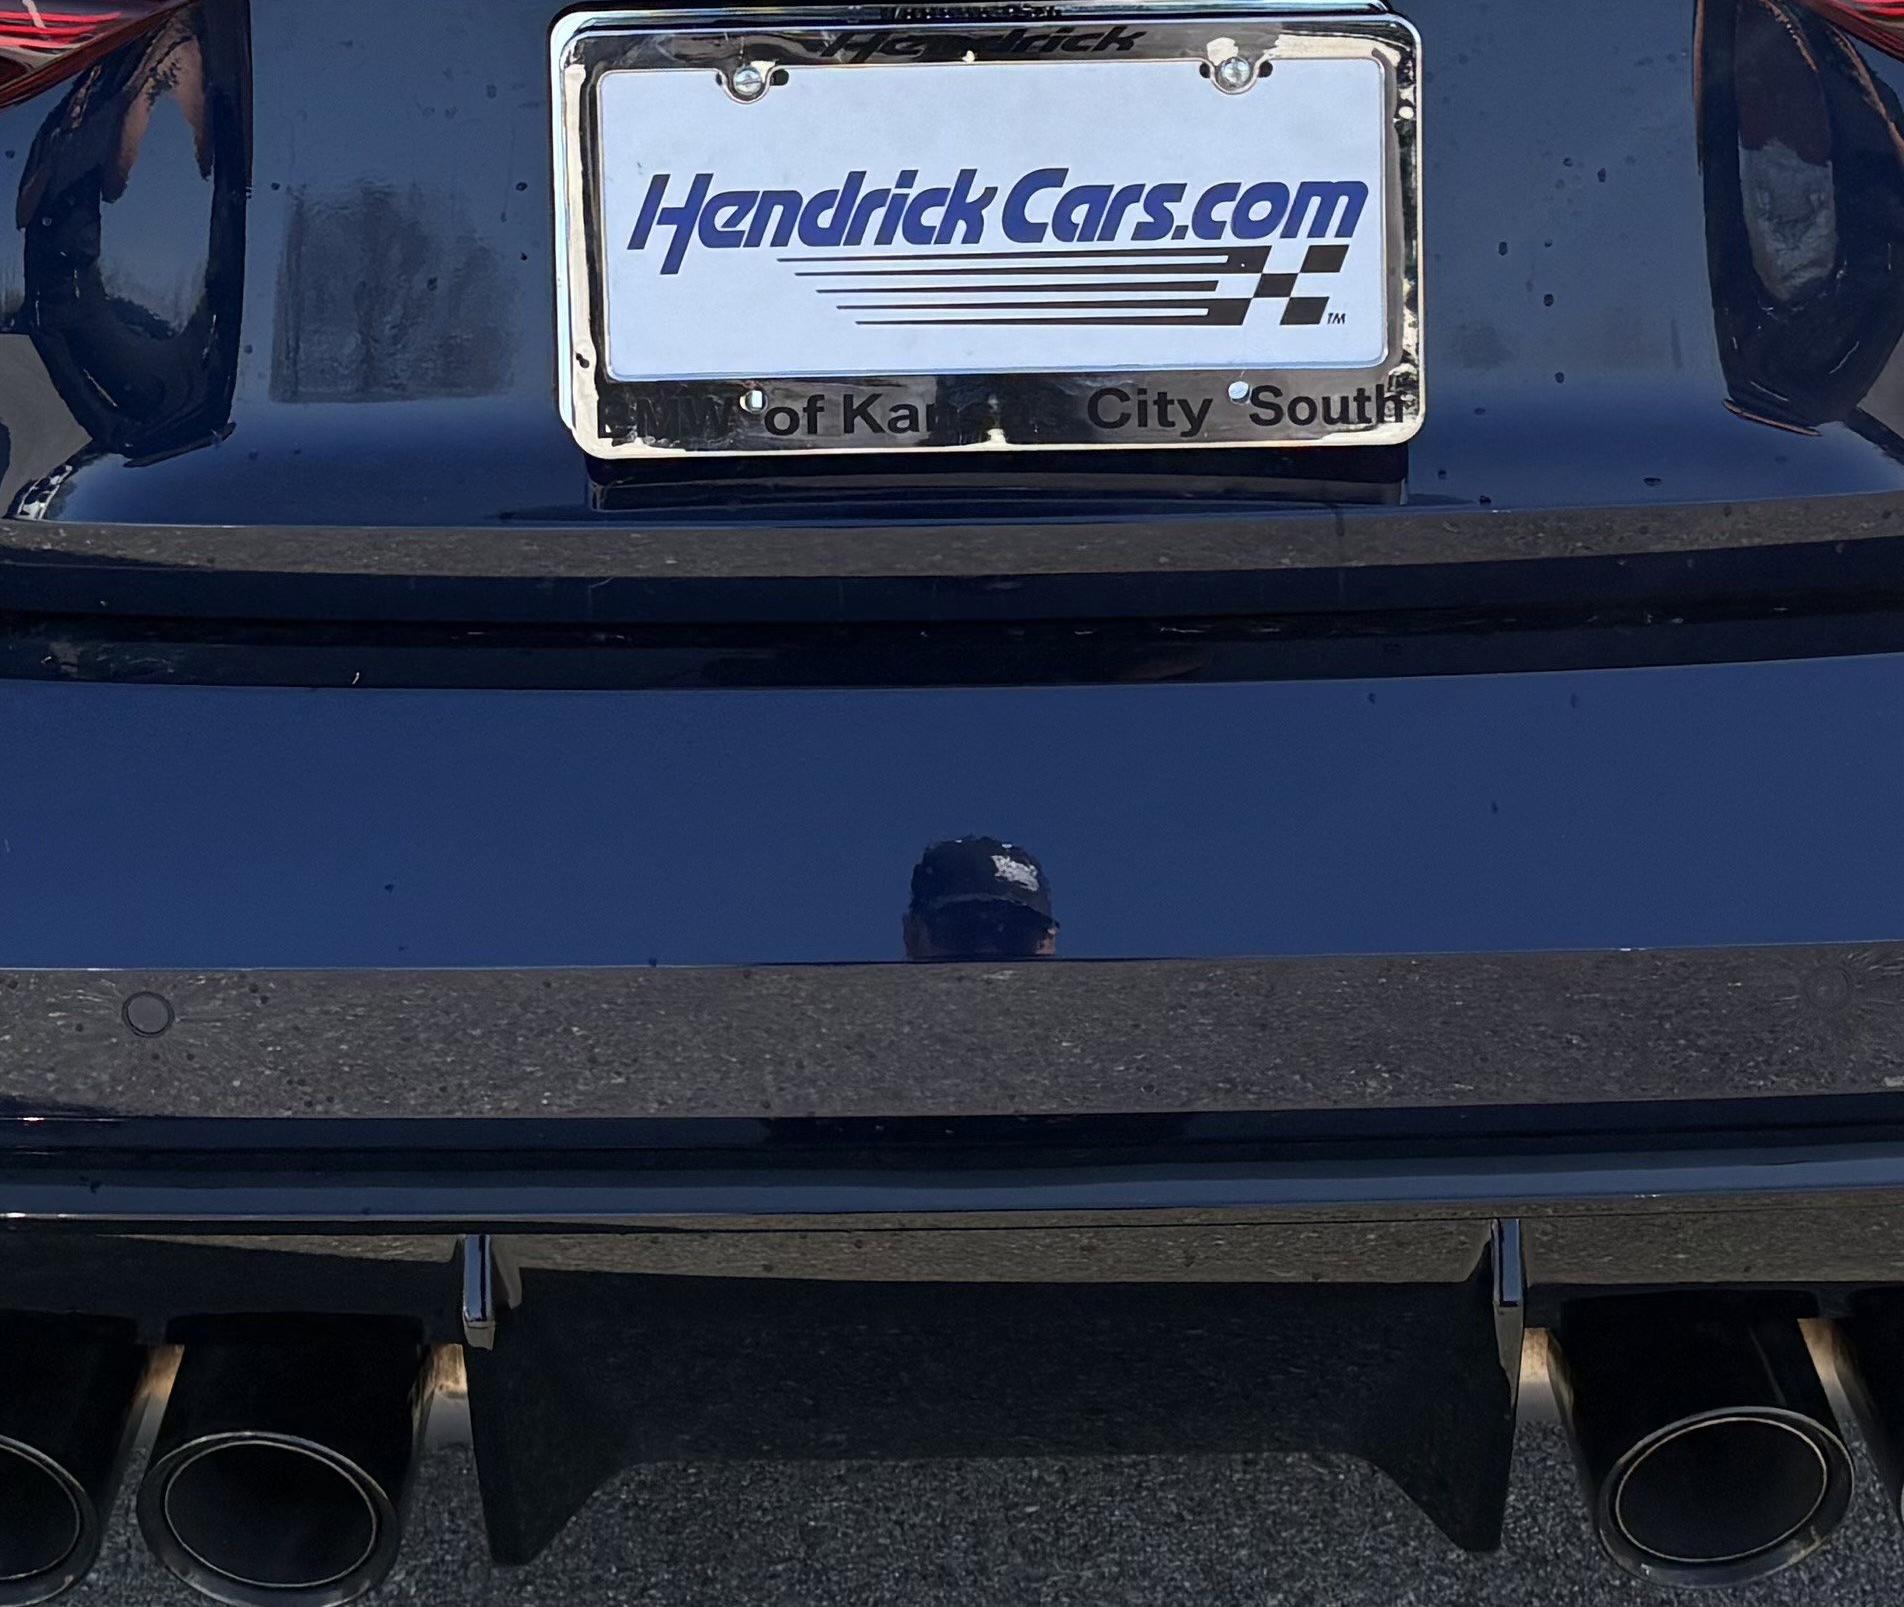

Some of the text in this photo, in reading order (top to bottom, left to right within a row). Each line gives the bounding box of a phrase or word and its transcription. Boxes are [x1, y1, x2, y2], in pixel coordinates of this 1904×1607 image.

[1327, 312, 1346, 325] TM
[601, 395, 734, 439] MW
[764, 393, 825, 436] of
[1086, 387, 1214, 438] City
[1248, 383, 1405, 427] South
